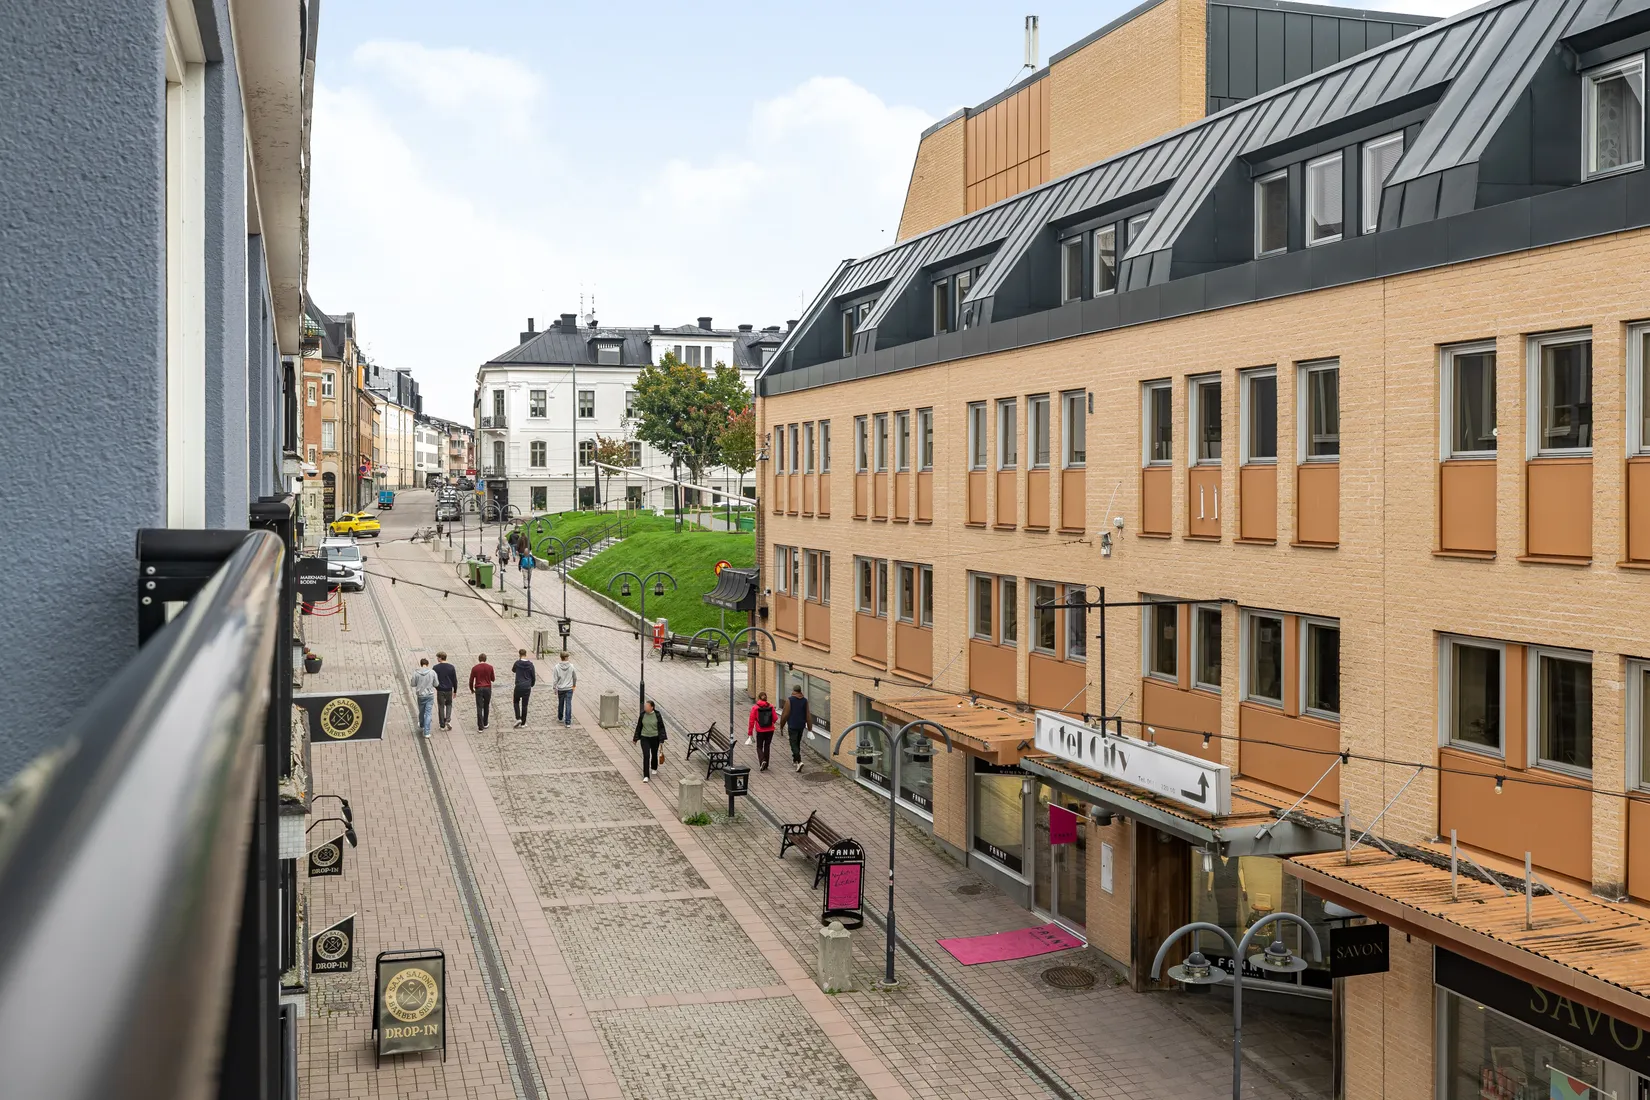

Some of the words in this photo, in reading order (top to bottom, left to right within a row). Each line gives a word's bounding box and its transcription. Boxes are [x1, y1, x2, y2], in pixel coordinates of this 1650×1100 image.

[324, 702, 336, 716] SAM
[337, 700, 360, 714] SALONG
[323, 722, 346, 737] BARBER
[348, 720, 360, 734] SHOP
[1090, 736, 1130, 774] City
[912, 793, 926, 806] FANNY
[990, 845, 1006, 860] FANNY
[1337, 942, 1384, 959] SAVON
[389, 974, 404, 992] SAM
[406, 971, 434, 989] SALONG
[389, 1001, 417, 1019] BARBER
[419, 998, 434, 1016] SHOP
[1530, 984, 1650, 1058] SAVO
[385, 1024, 438, 1039] DROP-IN
